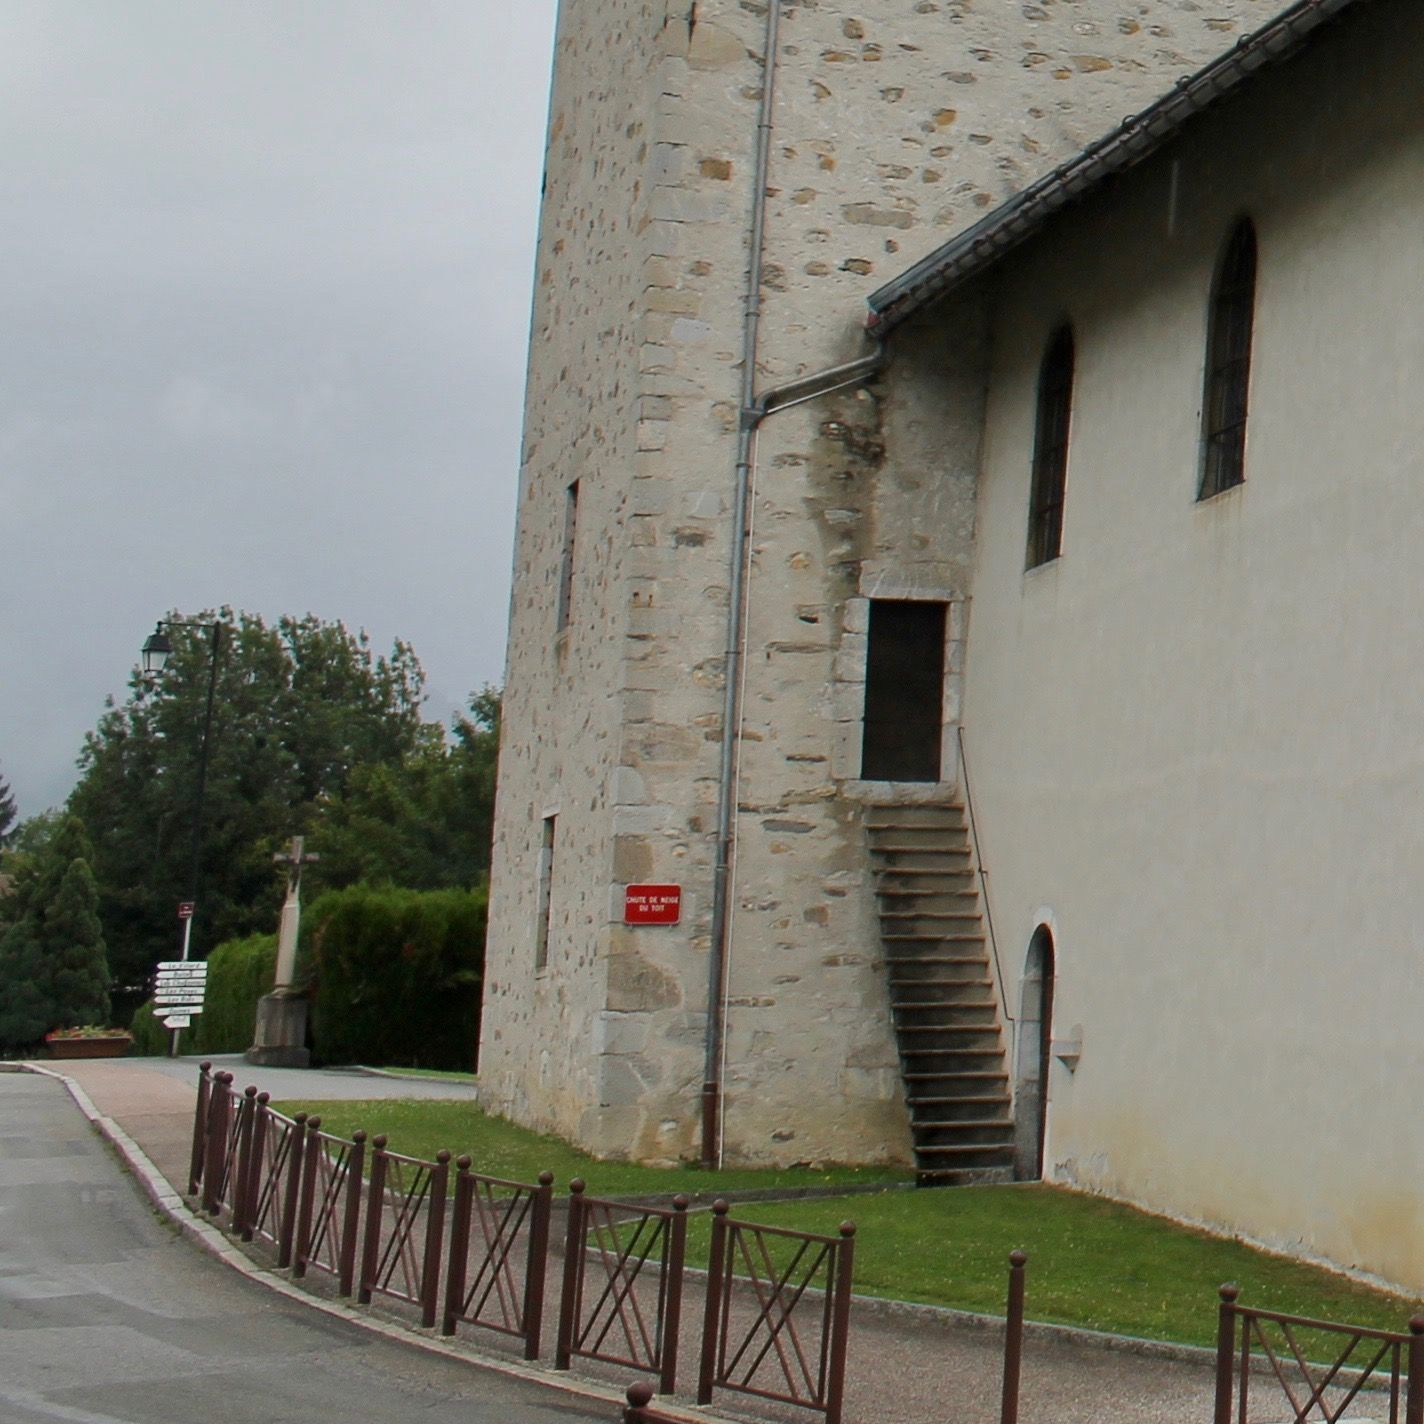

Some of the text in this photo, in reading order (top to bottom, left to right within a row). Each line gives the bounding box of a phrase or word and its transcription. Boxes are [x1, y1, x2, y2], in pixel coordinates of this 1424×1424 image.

[627, 896, 678, 904] CHUTE DE NEIGE
[639, 904, 665, 912] DU TOIT
